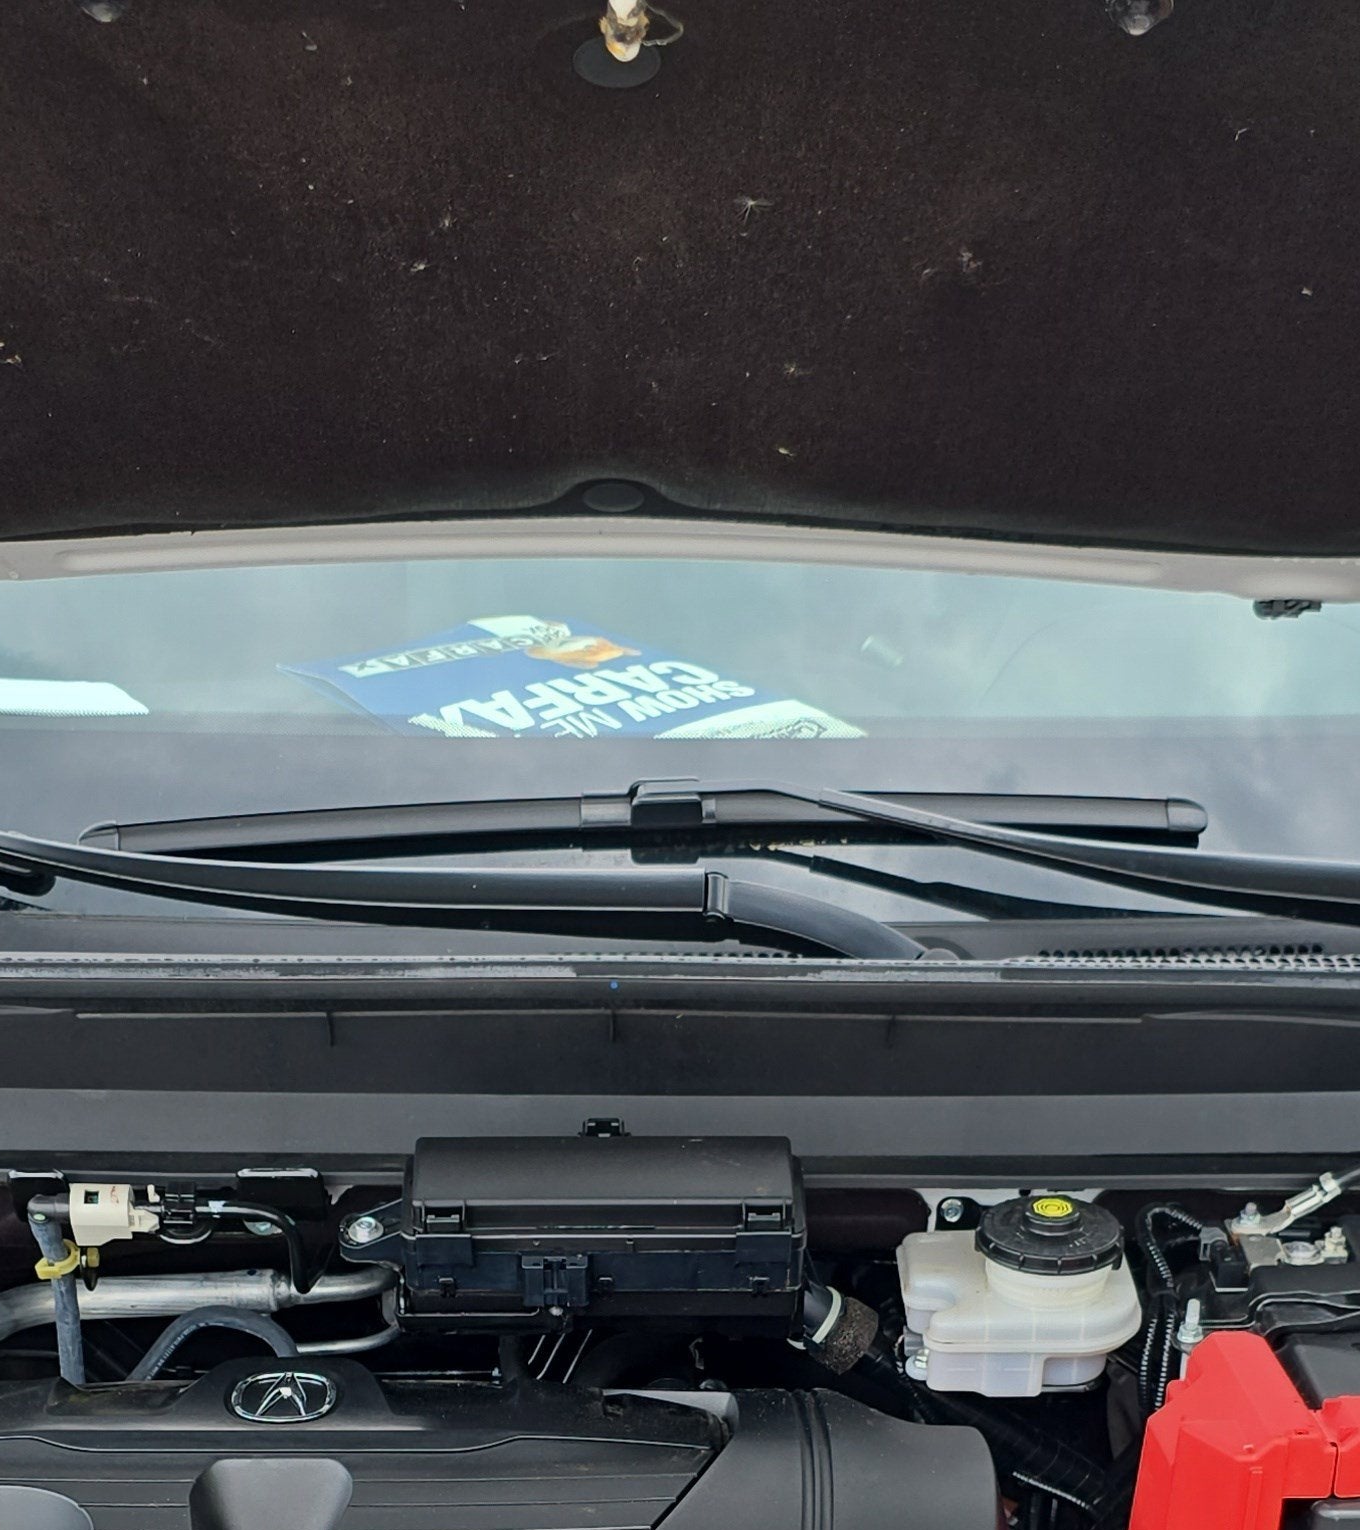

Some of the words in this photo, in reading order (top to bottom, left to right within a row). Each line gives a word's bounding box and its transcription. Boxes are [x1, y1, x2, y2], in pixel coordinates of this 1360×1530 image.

[340, 636, 534, 677] CARFAX
[408, 660, 720, 737] CARFAX
[617, 680, 756, 722] SHOW
[540, 702, 623, 738] ME
